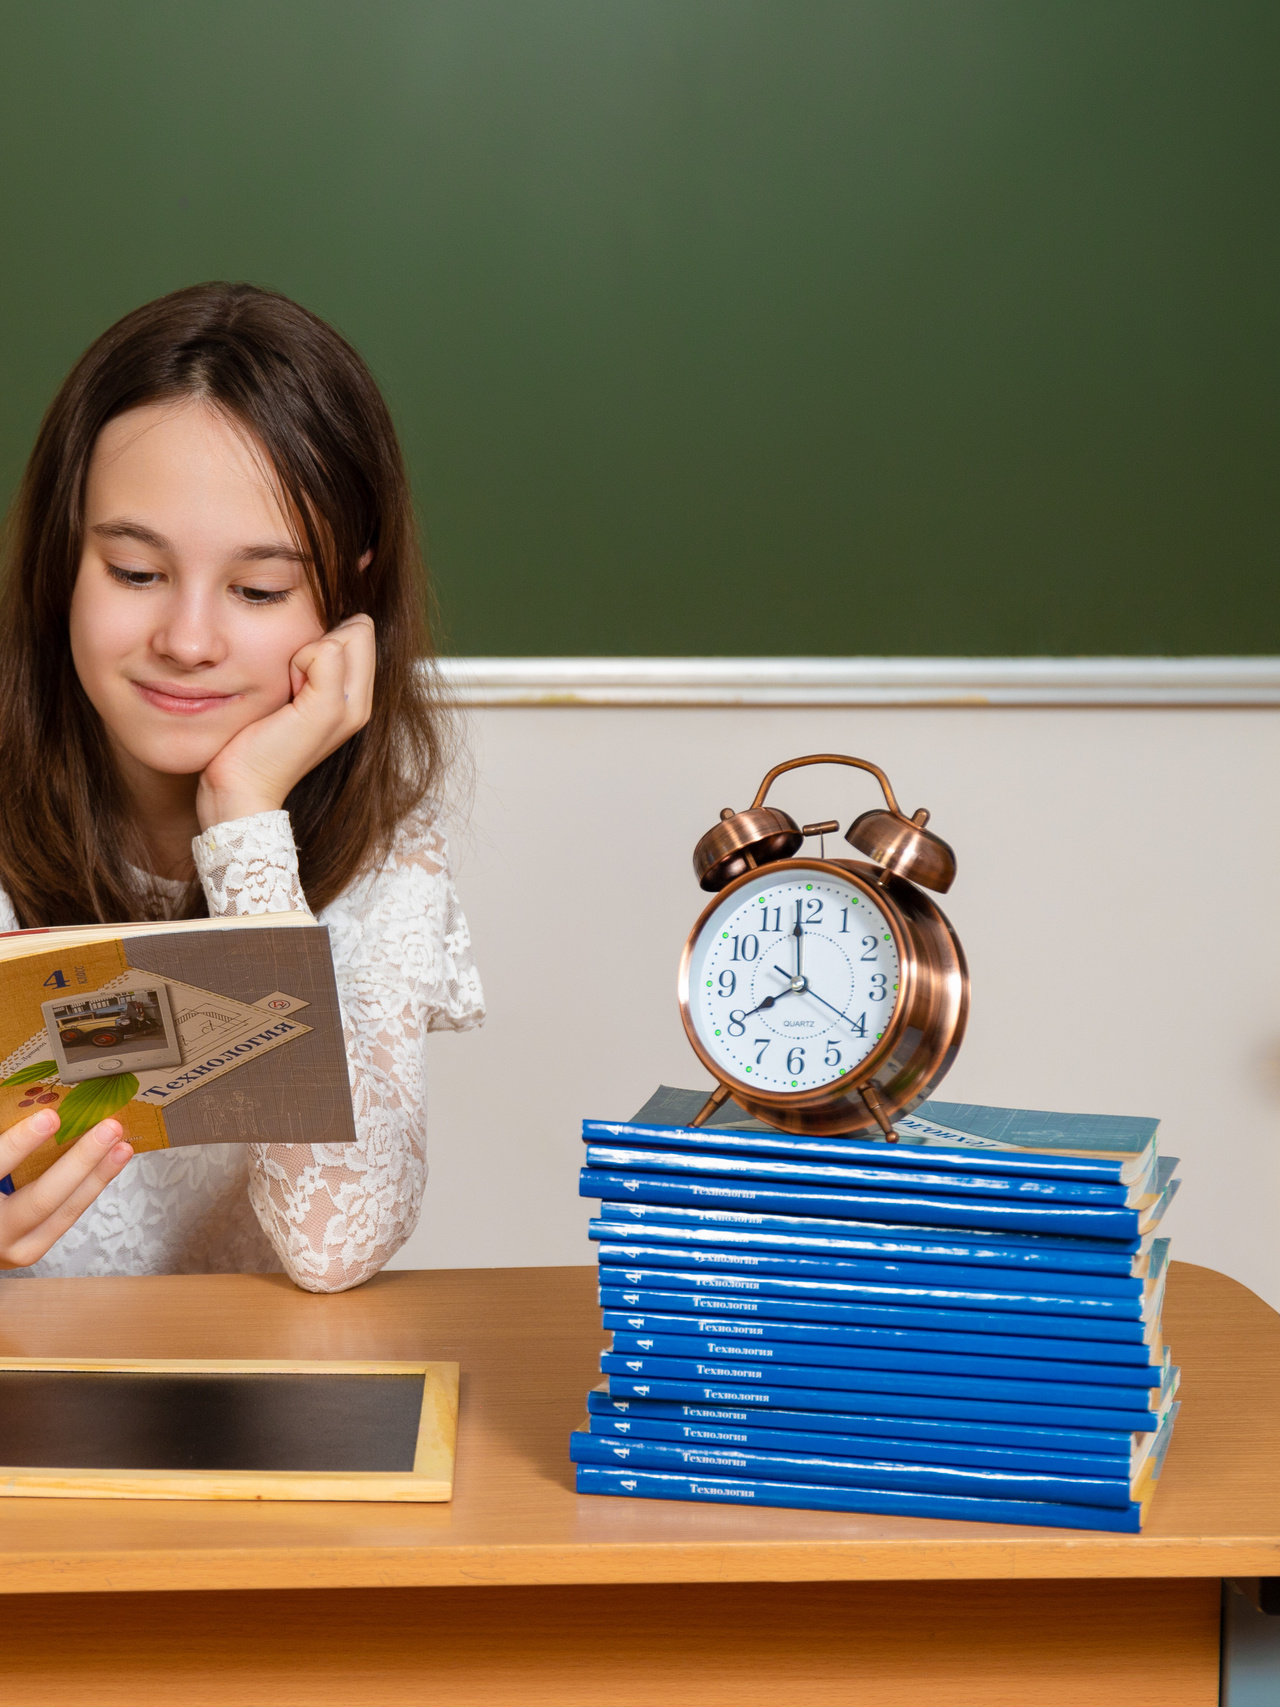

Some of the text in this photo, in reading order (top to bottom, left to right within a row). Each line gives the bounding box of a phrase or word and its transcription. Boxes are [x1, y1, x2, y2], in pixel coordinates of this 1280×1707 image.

[758, 906, 784, 932] 11
[838, 907, 852, 933] 1
[729, 934, 760, 962] 10
[860, 935, 879, 962] 2
[43, 969, 72, 990] 4
[718, 969, 736, 998] 9
[869, 973, 887, 1001] 3
[727, 1009, 747, 1037] 8
[783, 1020, 815, 1028] QUARTZ
[851, 1011, 869, 1038] 4
[141, 1021, 296, 1100] Технология
[753, 1038, 771, 1065] 7
[786, 1047, 806, 1075] 6
[824, 1040, 842, 1066] 5
[623, 1179, 640, 1192] 4
[625, 1272, 642, 1284] 4
[622, 1294, 758, 1311] 4 Технология
[627, 1318, 763, 1335] 4 Технология
[636, 1339, 774, 1357] 4 Технология
[626, 1360, 762, 1378] 4 Технология
[632, 1385, 770, 1402] 4 Технология
[613, 1402, 747, 1420] 4 Технология
[614, 1422, 747, 1442] 4 Технология
[613, 1448, 747, 1467] 4 Технология
[620, 1480, 755, 1498] 4 Технология
